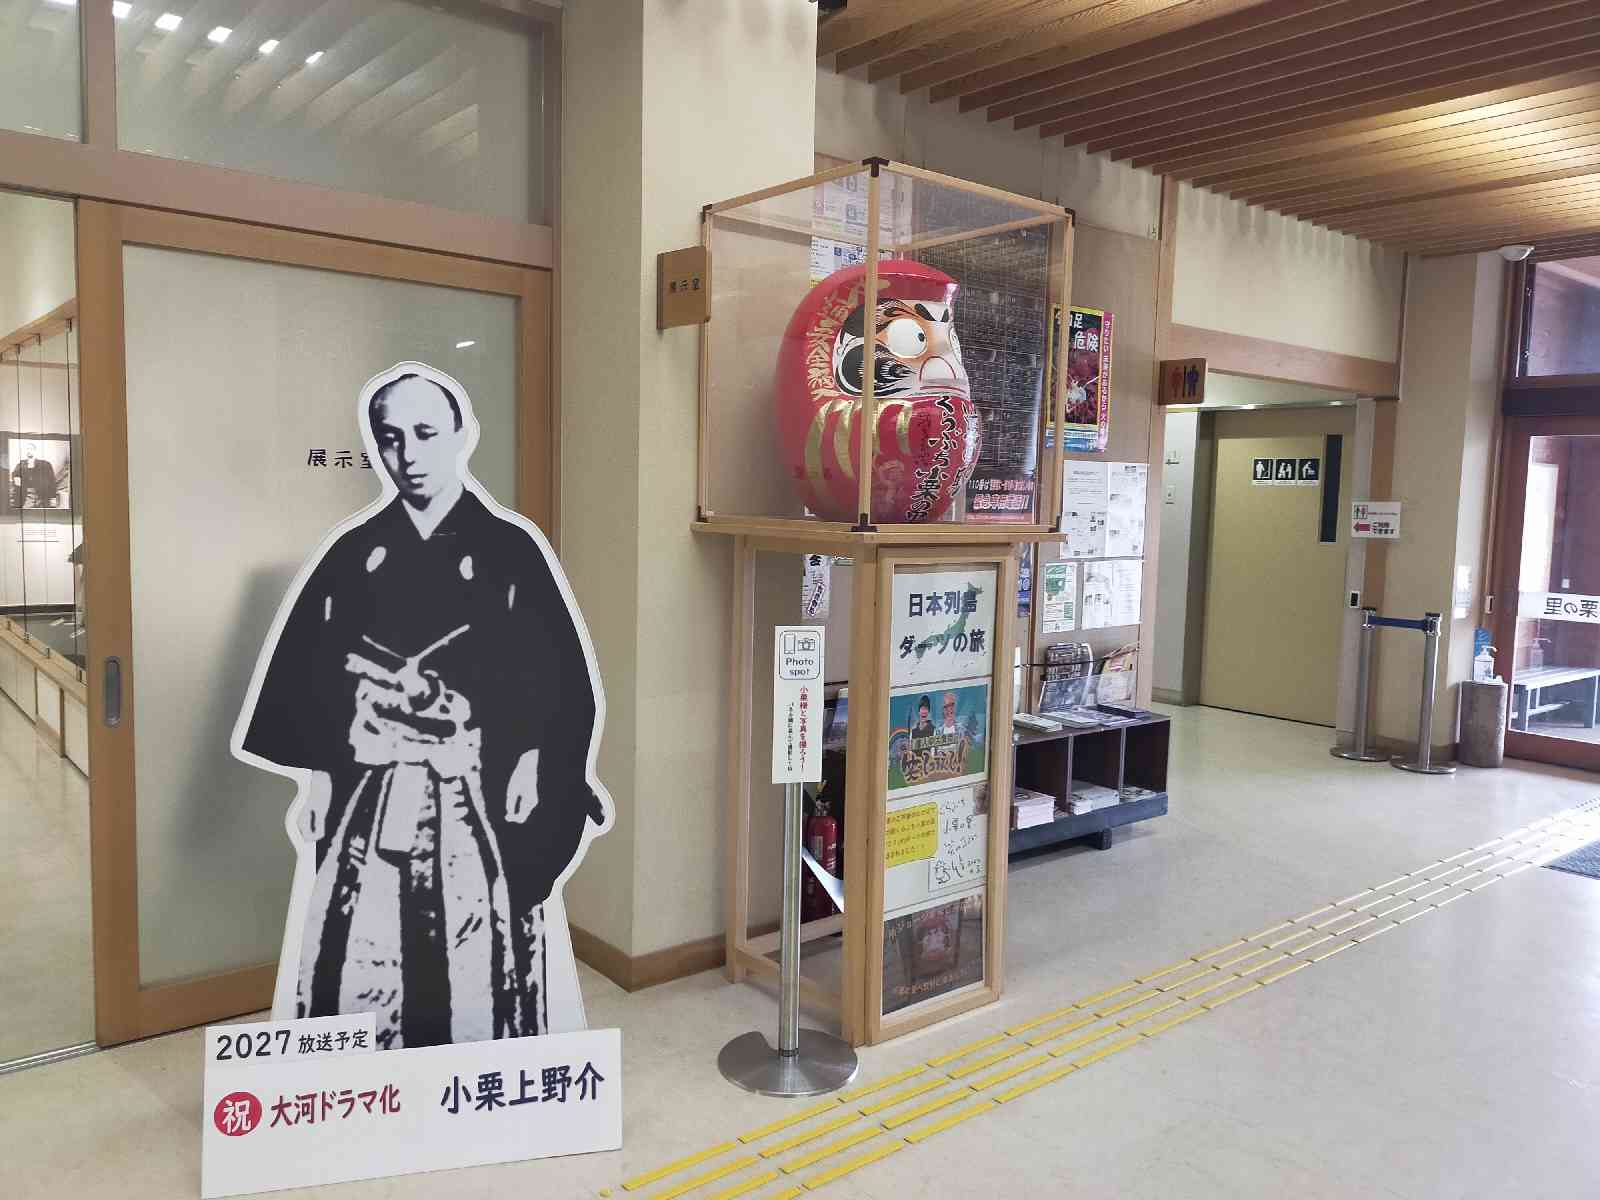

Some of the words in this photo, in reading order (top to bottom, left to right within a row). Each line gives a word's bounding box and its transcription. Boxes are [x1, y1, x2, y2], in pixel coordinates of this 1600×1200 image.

[1073, 331, 1099, 352] 危険
[909, 591, 977, 617] 日本列島
[785, 657, 814, 667] Photo
[789, 667, 810, 677] spot
[216, 1030, 291, 1061] 2027
[298, 1028, 369, 1054] 放送予定
[440, 1061, 605, 1114] 小栗上野介
[222, 1099, 252, 1134] 祝
[270, 1083, 401, 1128] 大河ドラマ化
